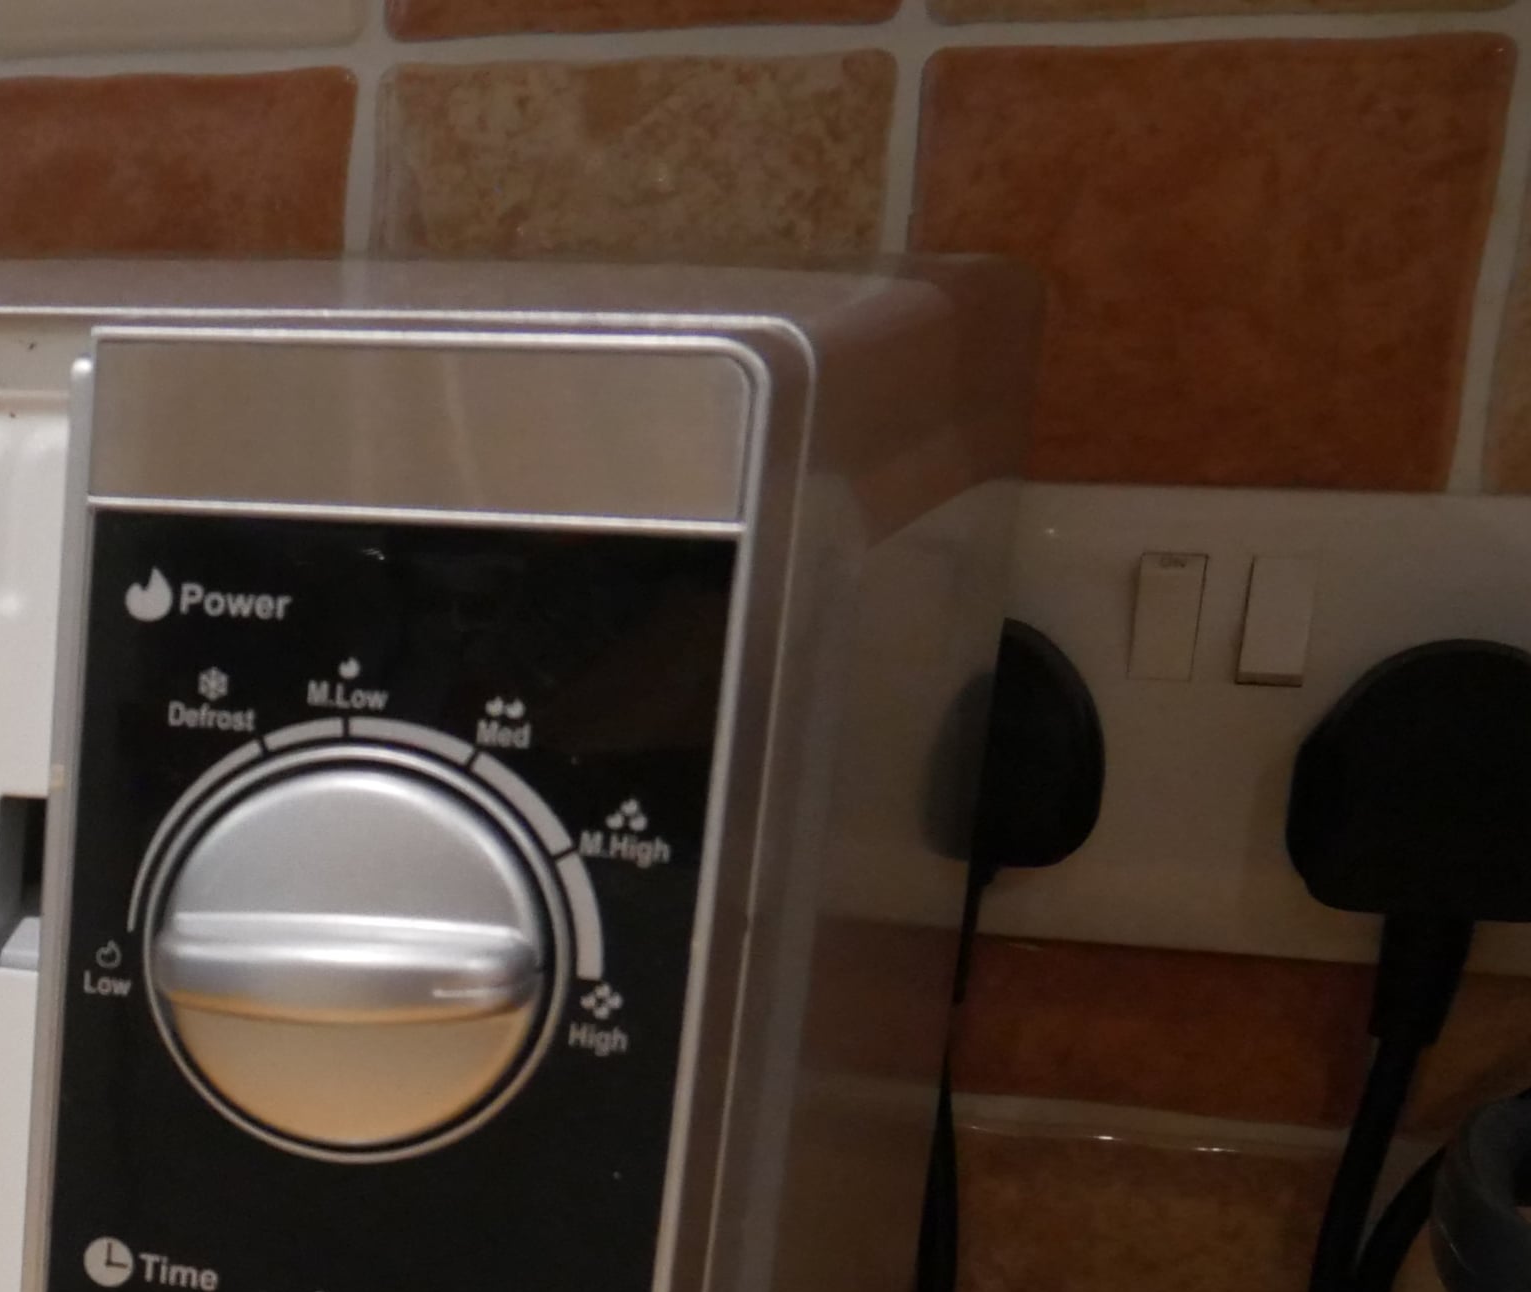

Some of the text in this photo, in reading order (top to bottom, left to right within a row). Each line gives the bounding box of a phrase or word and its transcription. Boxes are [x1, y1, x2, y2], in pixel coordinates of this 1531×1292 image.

[180, 582, 292, 620] Power
[307, 681, 388, 711] M.Low
[168, 702, 255, 732] Defrost
[477, 720, 531, 750] Med
[580, 832, 670, 864] M.High
[83, 971, 131, 997] Low
[568, 1023, 628, 1053] High
[140, 1253, 219, 1292] Time
